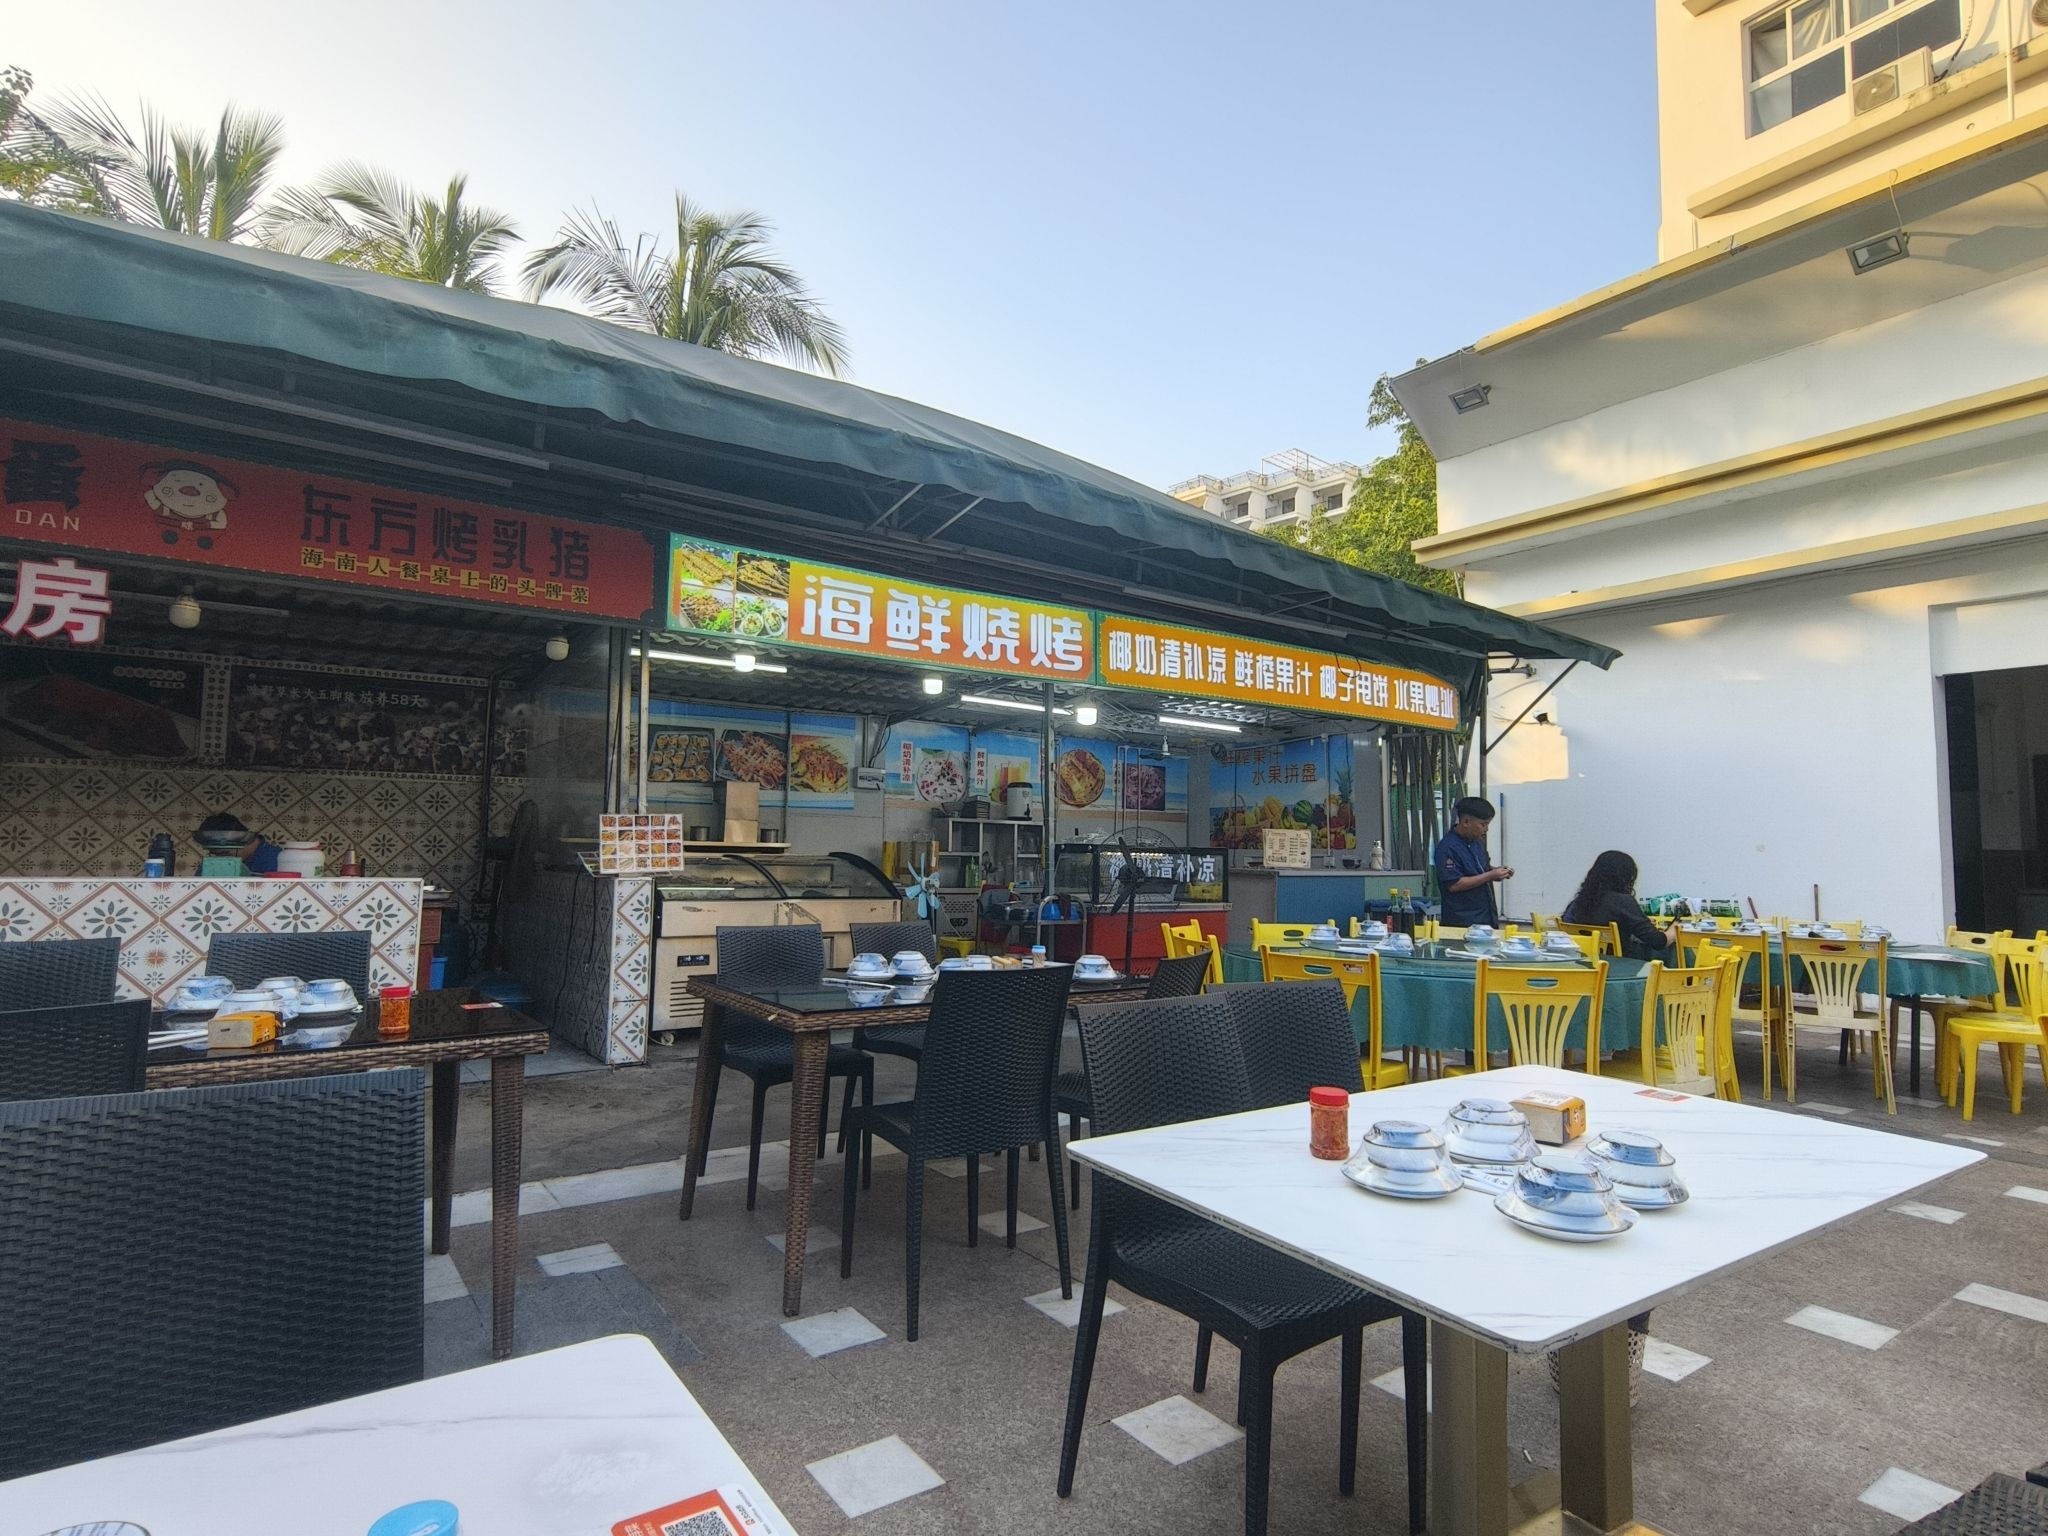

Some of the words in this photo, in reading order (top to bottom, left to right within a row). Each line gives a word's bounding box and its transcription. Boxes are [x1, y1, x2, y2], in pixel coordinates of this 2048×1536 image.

[15, 509, 80, 531] DAN
[301, 484, 590, 582] 东方烤乳猪
[0, 557, 112, 645] 房
[301, 547, 590, 605] 海南人餐桌上的头牌菜
[801, 575, 1084, 672] 海鲜烧烤
[1109, 631, 1227, 684] 椰奶清补凉
[1235, 650, 1313, 696] 鲜榨果汁
[1320, 664, 1388, 707] 椰子甩饼
[1252, 763, 1318, 786] 水果拼盘
